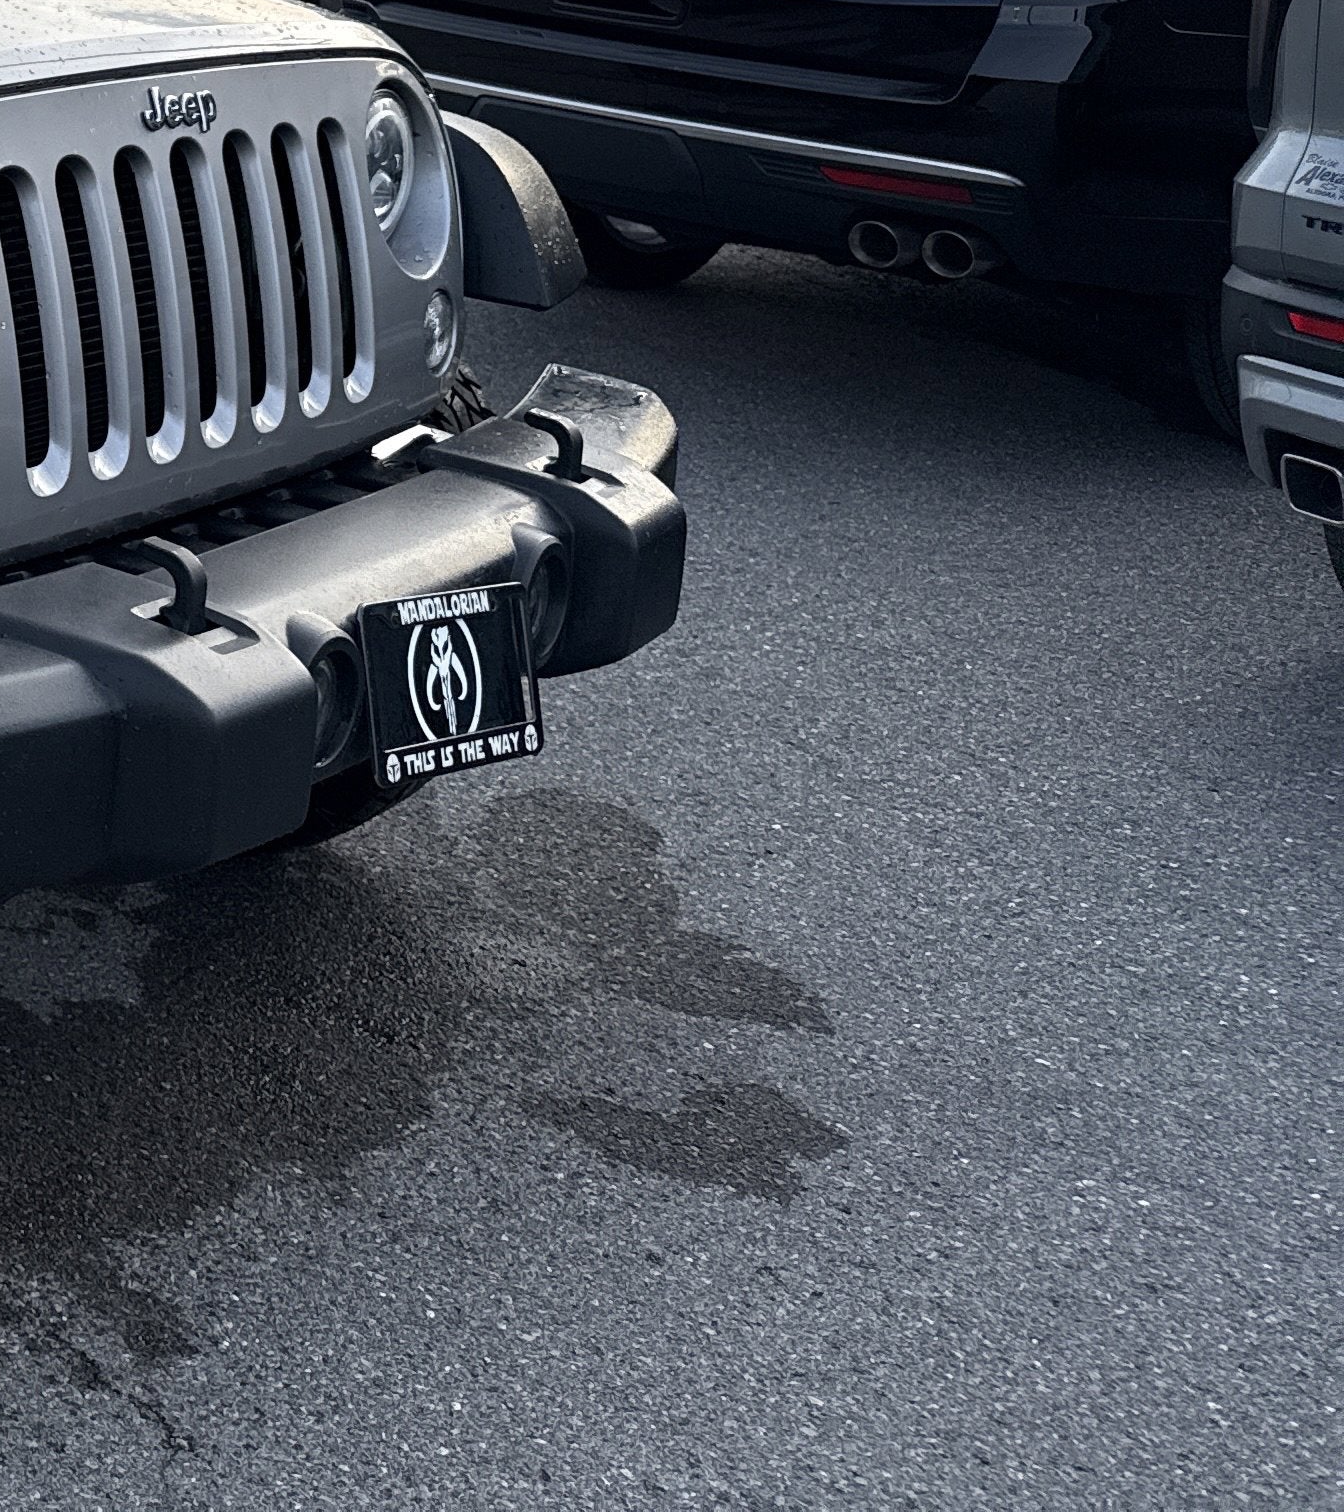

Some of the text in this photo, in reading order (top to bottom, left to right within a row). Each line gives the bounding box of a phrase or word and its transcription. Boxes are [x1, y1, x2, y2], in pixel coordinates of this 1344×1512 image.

[140, 86, 217, 133] Jeep
[397, 590, 490, 626] MANDALORIAN
[403, 731, 520, 776] THIS IS THE WAY
